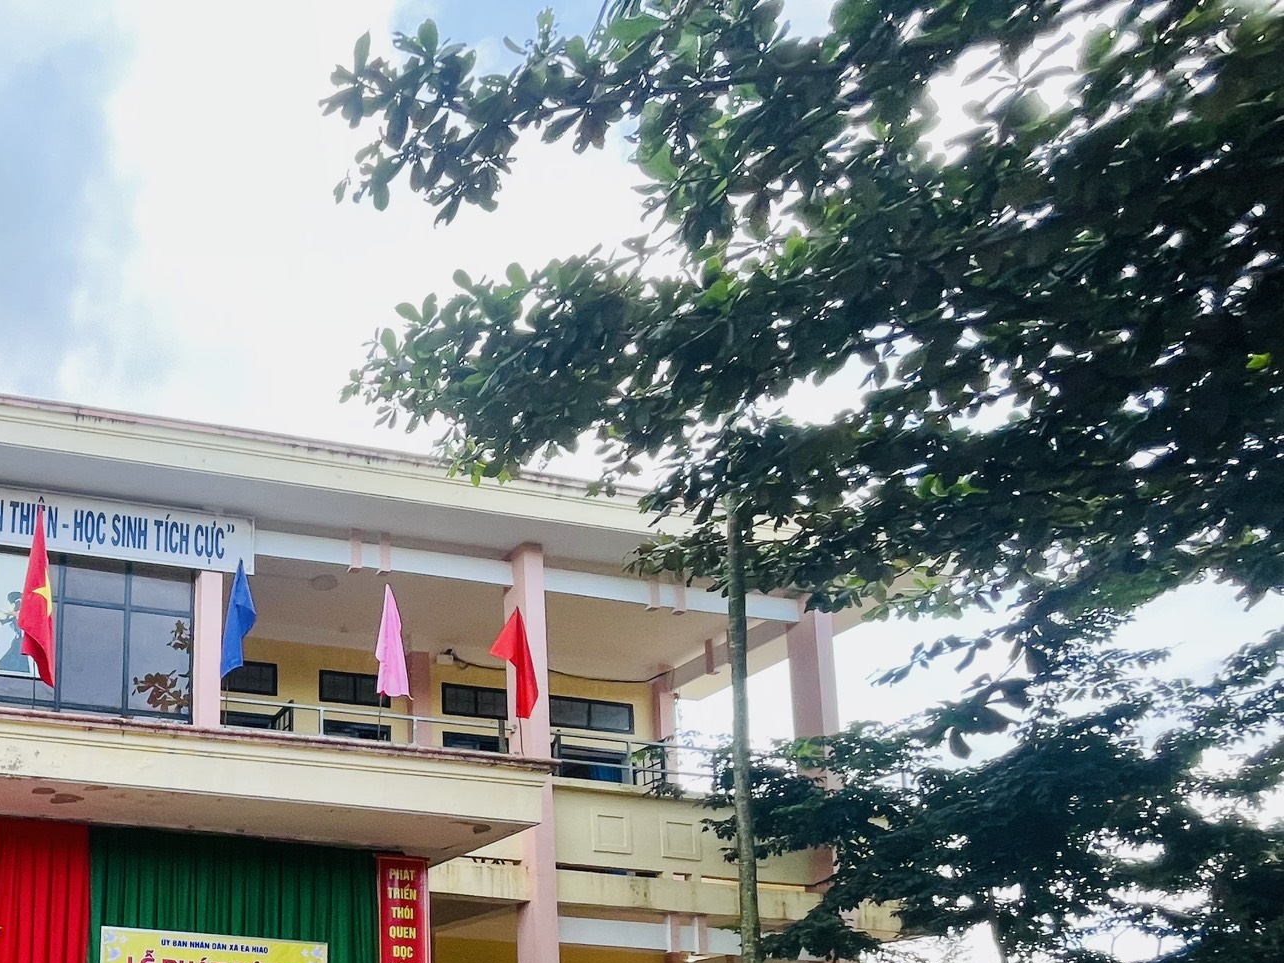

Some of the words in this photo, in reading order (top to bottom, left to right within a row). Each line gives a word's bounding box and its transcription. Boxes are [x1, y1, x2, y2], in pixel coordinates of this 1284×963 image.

[73, 509, 106, 550] HỌC
[111, 514, 148, 550] SINH
[154, 514, 190, 555] TÍCH
[389, 926, 416, 940] QUEN
[393, 945, 413, 959] ĐỌC
